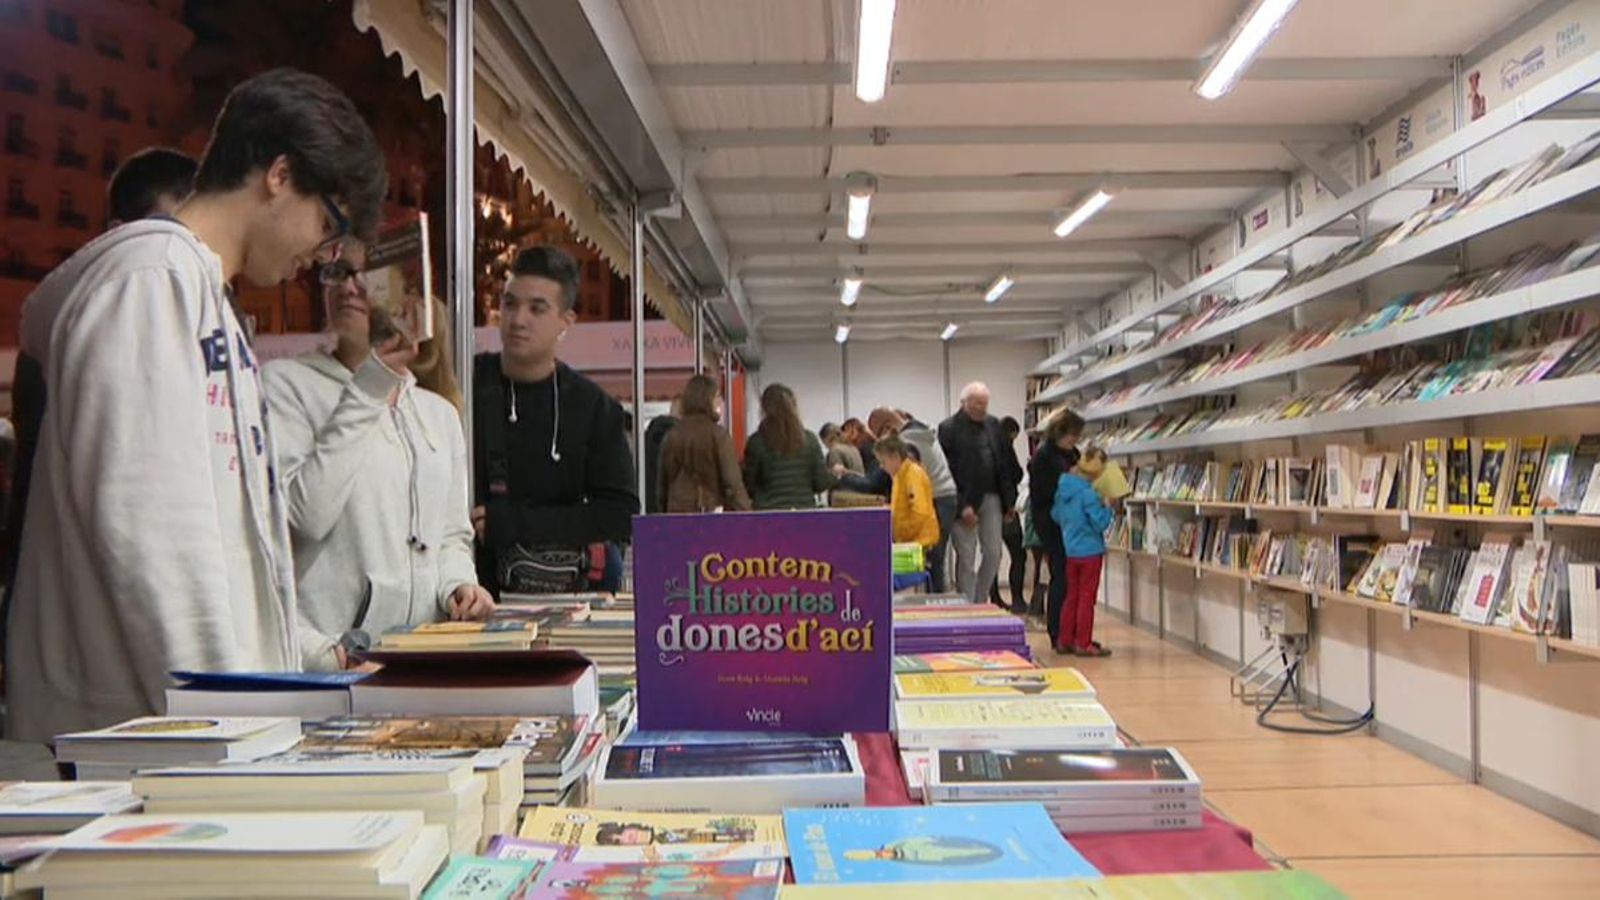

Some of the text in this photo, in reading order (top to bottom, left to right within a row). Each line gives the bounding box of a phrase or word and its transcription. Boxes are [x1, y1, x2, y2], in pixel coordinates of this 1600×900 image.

[700, 552, 833, 583] Contem
[684, 561, 862, 622] Històries de
[656, 614, 784, 652] dones
